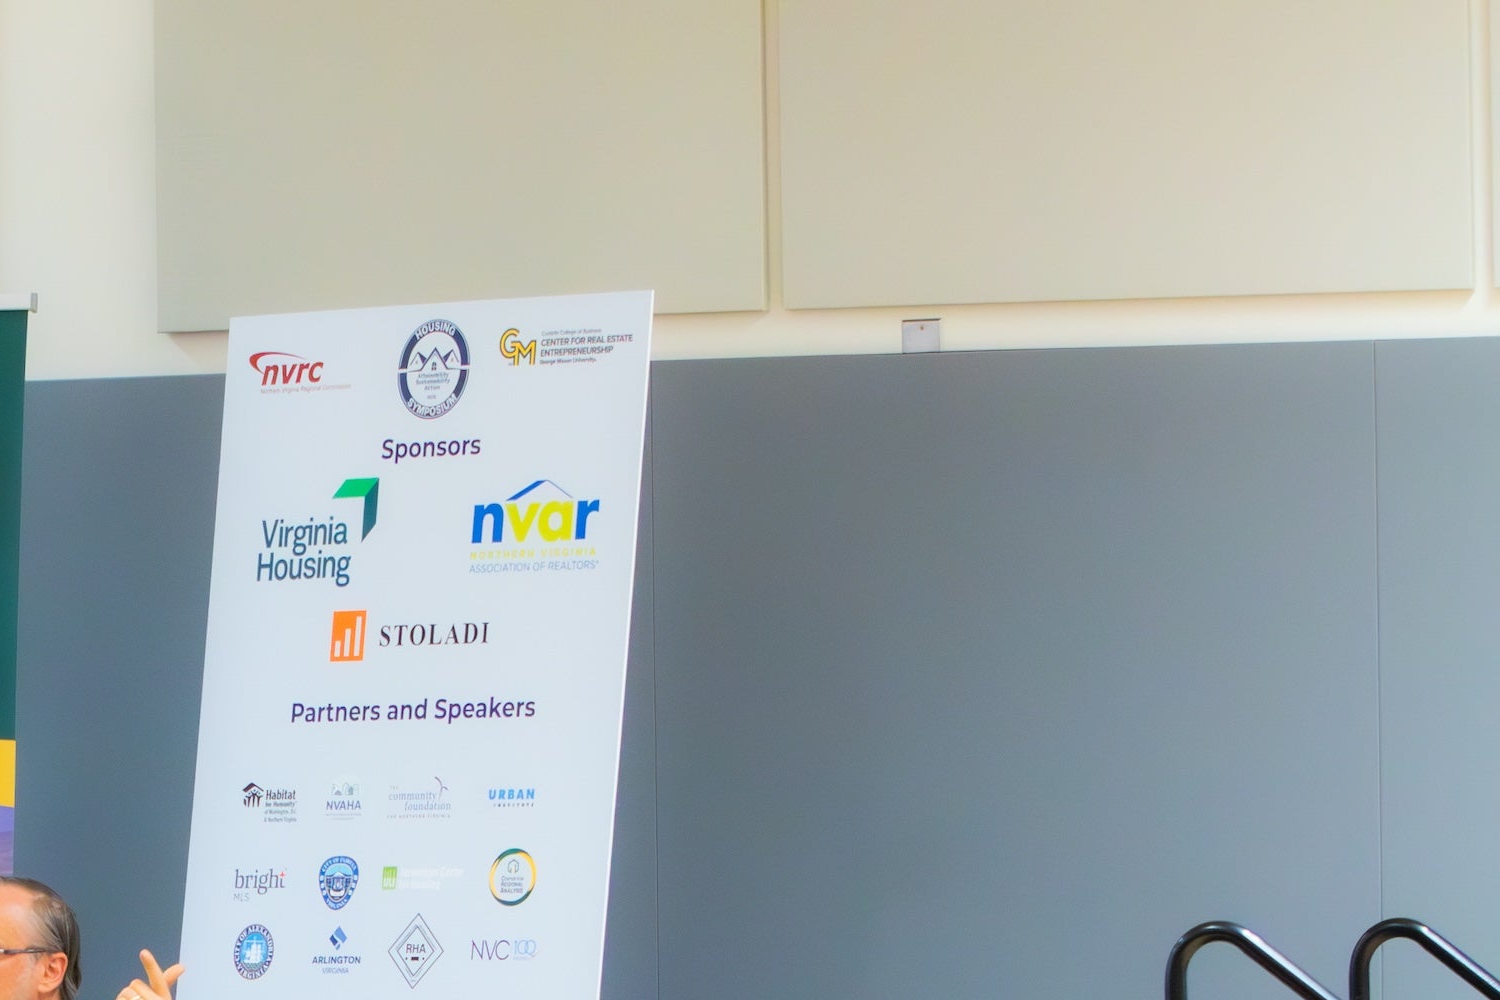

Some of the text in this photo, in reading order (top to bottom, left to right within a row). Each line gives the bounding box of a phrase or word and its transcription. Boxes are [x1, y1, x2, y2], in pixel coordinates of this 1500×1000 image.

[415, 321, 456, 340] HOUSING
[540, 334, 634, 347] CENTER FOR REAL ESTATE
[540, 346, 614, 358] ENTREPRENEURSHIP
[261, 361, 324, 386] nvrc
[407, 393, 458, 417] SYMPOSIUM
[381, 438, 481, 463] Sponsors
[471, 499, 600, 544] nvar
[261, 516, 348, 556] Virginia
[470, 547, 597, 561] NORTHERN VIRGINIA
[256, 550, 351, 587] Housing
[469, 562, 530, 574] ASSOCIATION
[532, 562, 546, 571] OF
[378, 622, 489, 647] STOLADI
[291, 697, 536, 724] Partners and Speakers
[266, 789, 296, 800] Habitat
[388, 791, 436, 802] community
[488, 788, 536, 800] URBAN
[326, 800, 362, 811] NVAHA
[404, 801, 451, 812] foundation
[235, 867, 286, 895] bright
[233, 892, 250, 902] MLS
[405, 943, 426, 954] RHA
[470, 939, 510, 961] NVC
[311, 956, 362, 964] ARLINGTON
